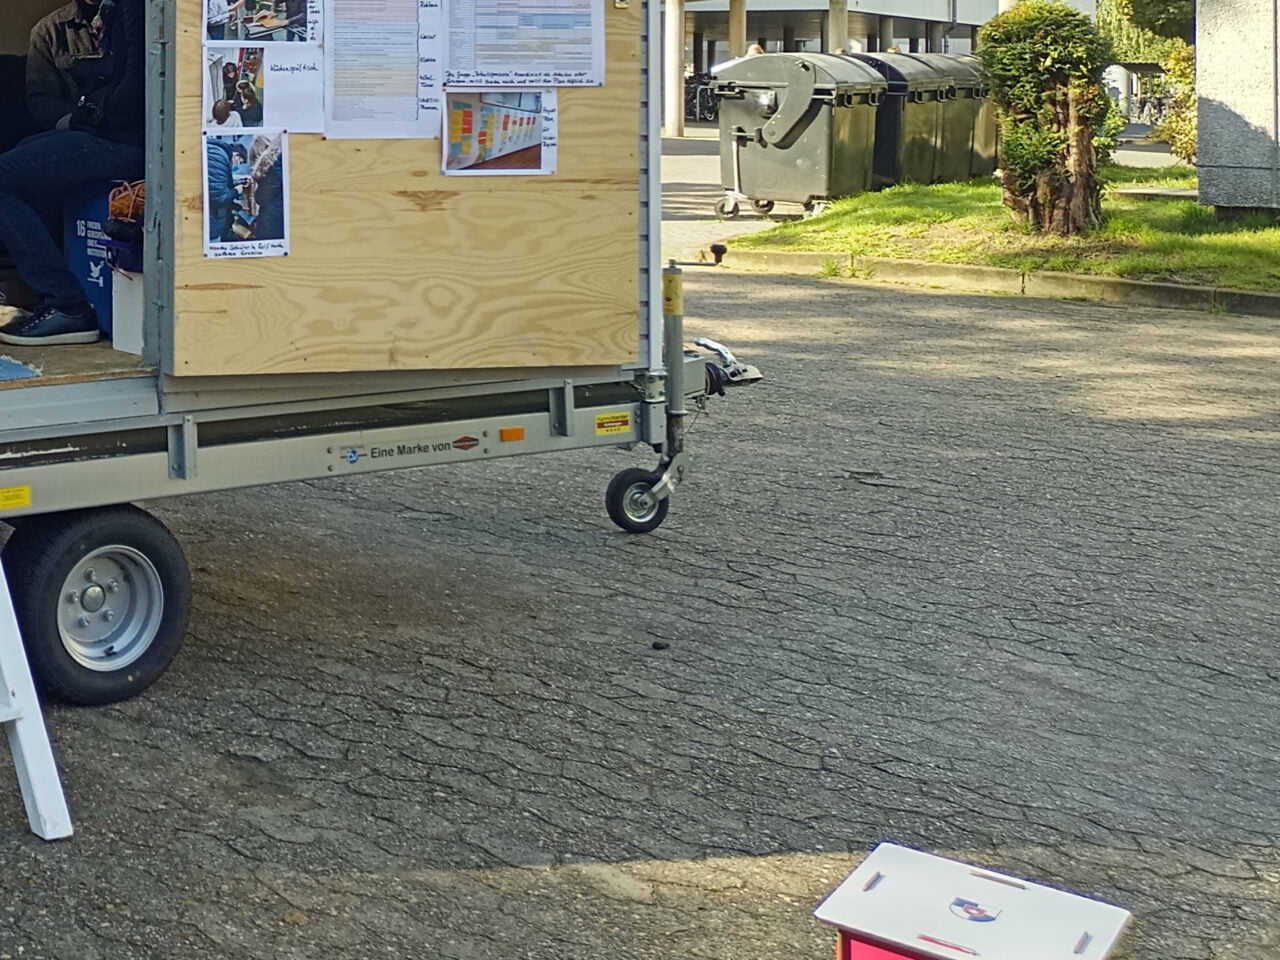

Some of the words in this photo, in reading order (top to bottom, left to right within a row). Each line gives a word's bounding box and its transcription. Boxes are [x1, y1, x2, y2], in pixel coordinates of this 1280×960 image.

[76, 220, 86, 237] 16
[370, 446, 394, 459] Eine
[397, 442, 429, 456] Marke
[432, 441, 451, 452] von
